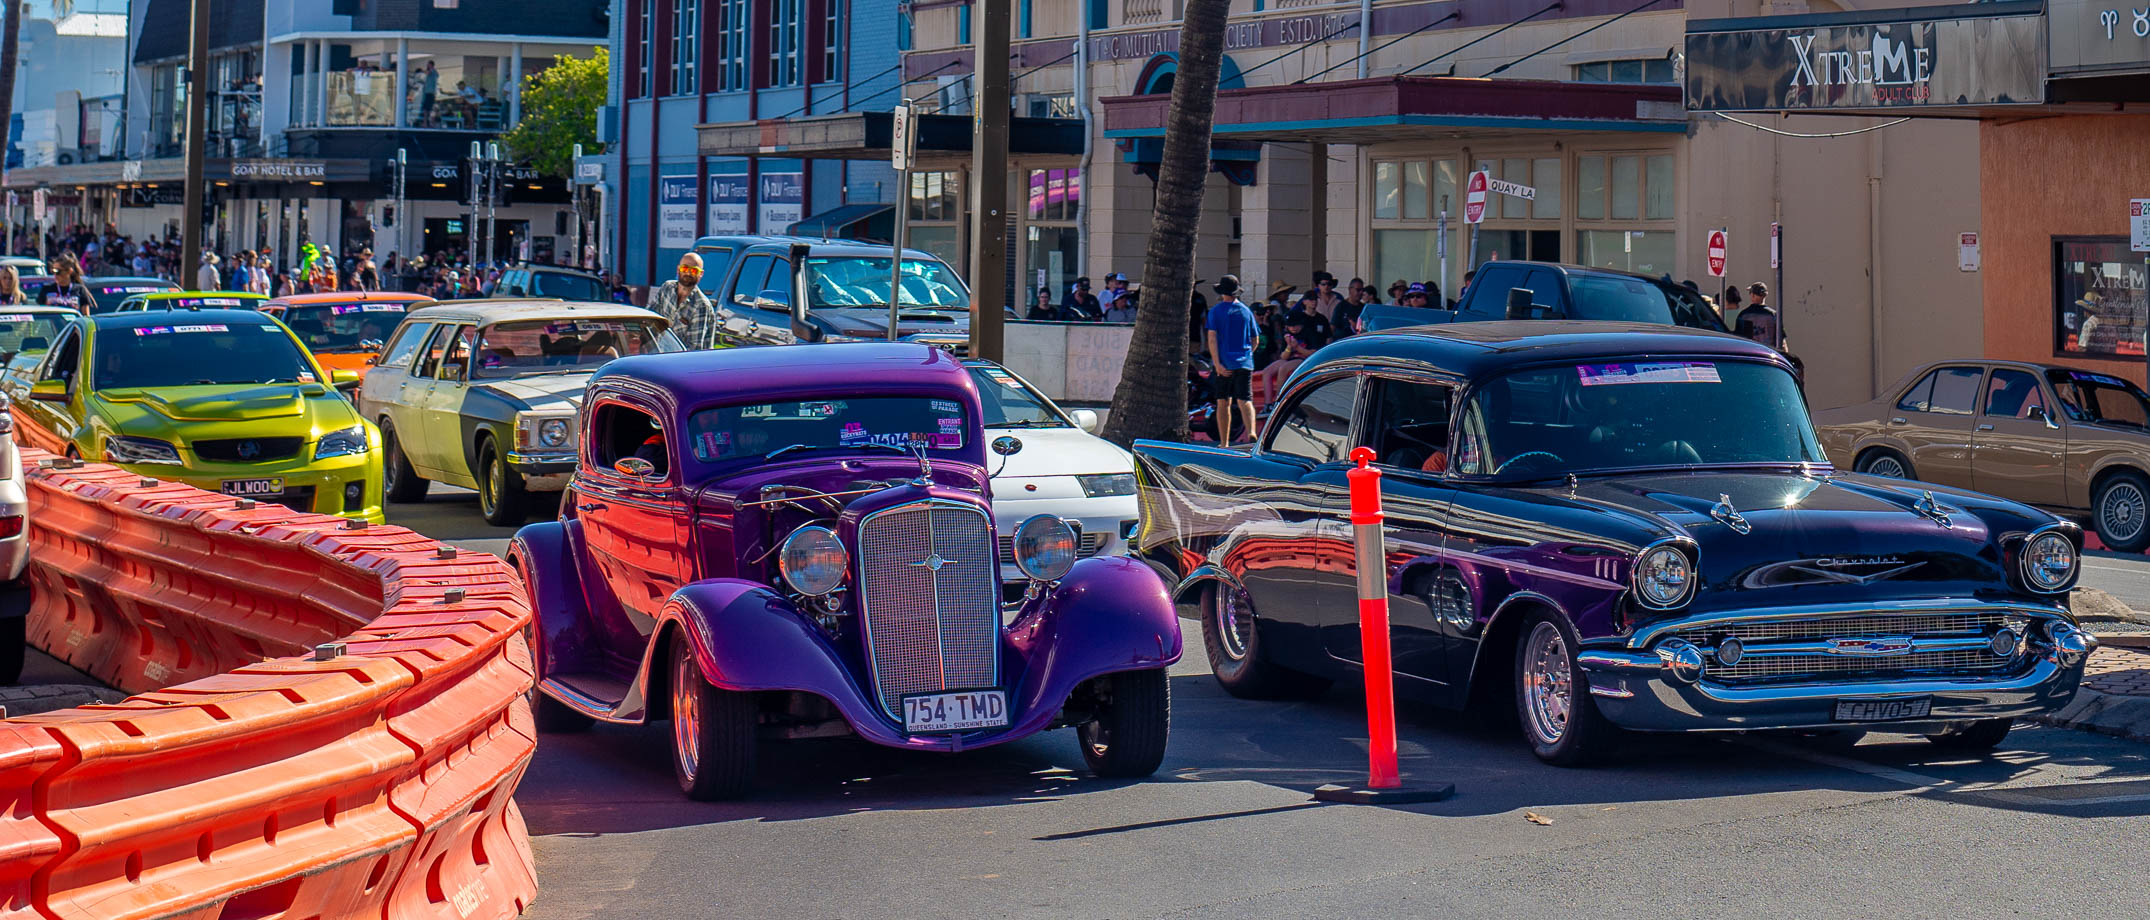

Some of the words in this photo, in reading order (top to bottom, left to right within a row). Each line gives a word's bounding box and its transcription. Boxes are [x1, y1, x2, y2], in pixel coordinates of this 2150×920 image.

[1125, 31, 1171, 57] MUTUAL
[1872, 87, 1903, 100] ADULT
[1905, 85, 1930, 100] CLUB
[232, 165, 258, 176] GOAT
[261, 165, 292, 176] HOTEL
[295, 166, 302, 176] &
[304, 166, 324, 176] BAR
[433, 168, 457, 178] GOA
[516, 169, 539, 179] BAR
[1475, 180, 1482, 189] NO
[1491, 181, 1517, 194] QUAY
[1520, 187, 1534, 198] LA
[1468, 205, 1482, 215] ENTRY
[1715, 236, 1722, 245] NO
[1711, 259, 1723, 268] ENTRY
[1815, 556, 1905, 567] Chevrolet
[908, 723, 948, 732] QUEENSLAND
[953, 720, 983, 728] SUNSHINE
